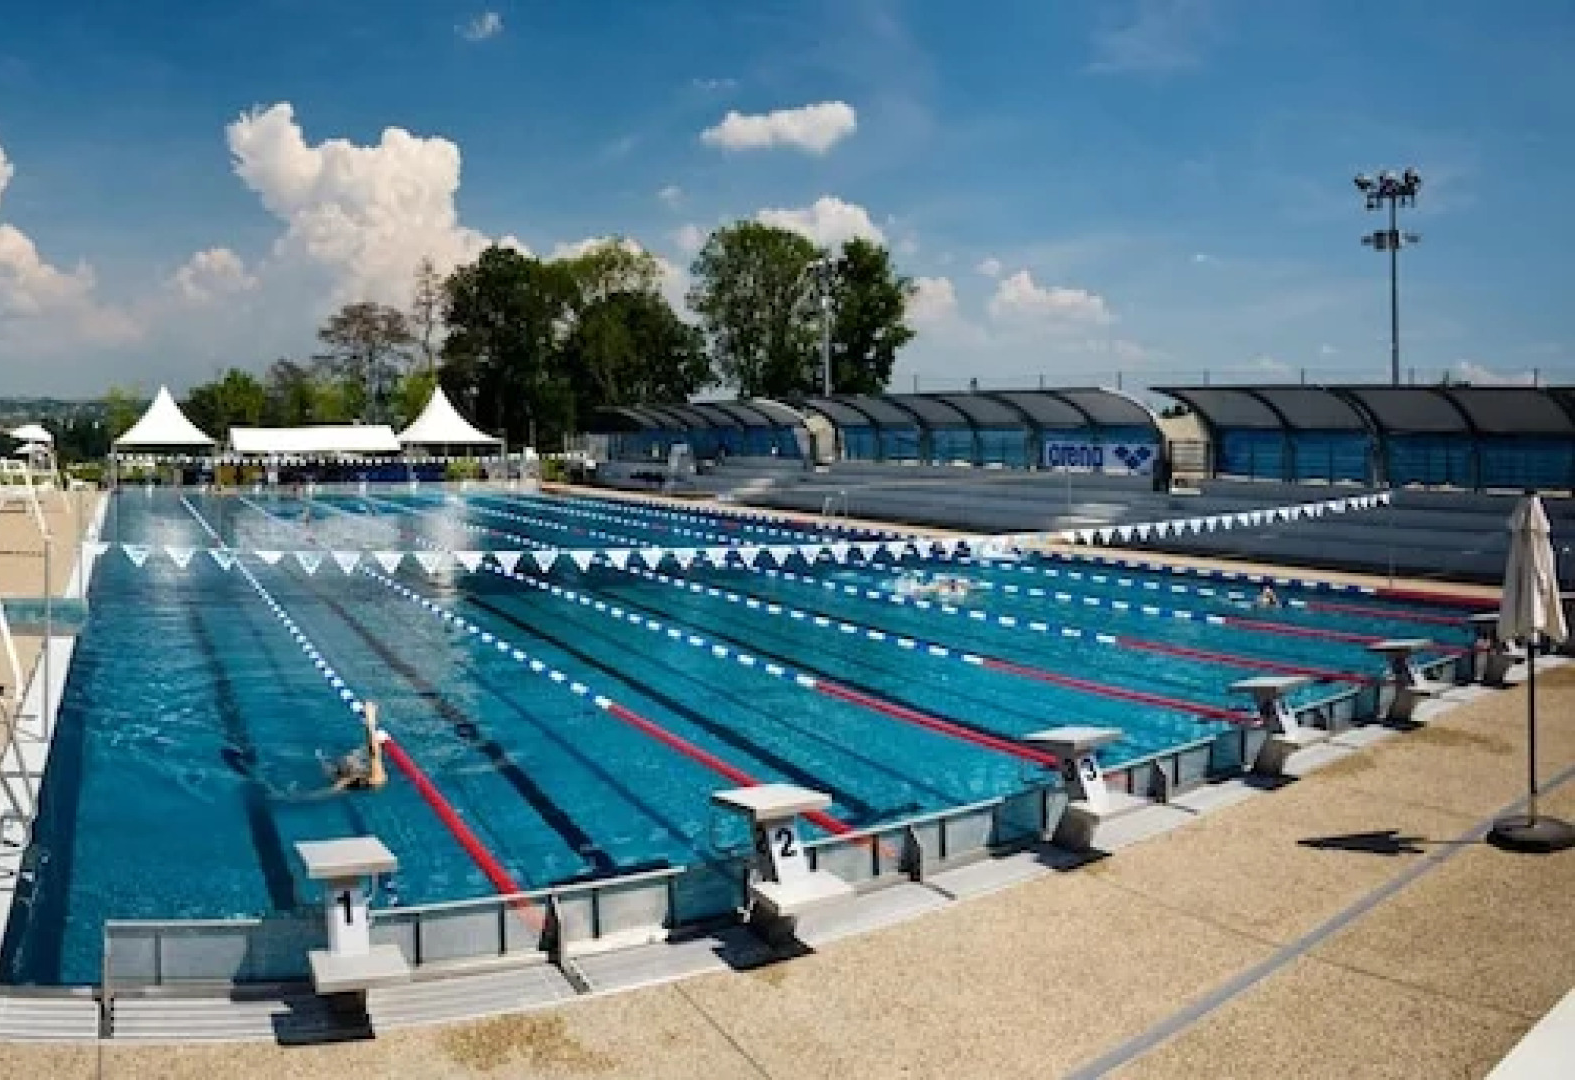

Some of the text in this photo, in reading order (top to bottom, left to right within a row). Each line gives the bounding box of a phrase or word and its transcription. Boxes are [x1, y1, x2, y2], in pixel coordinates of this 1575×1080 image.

[1048, 444, 1103, 466] arena
[1081, 758, 1097, 782] 3
[775, 827, 797, 857] 2
[336, 890, 353, 926] 1
